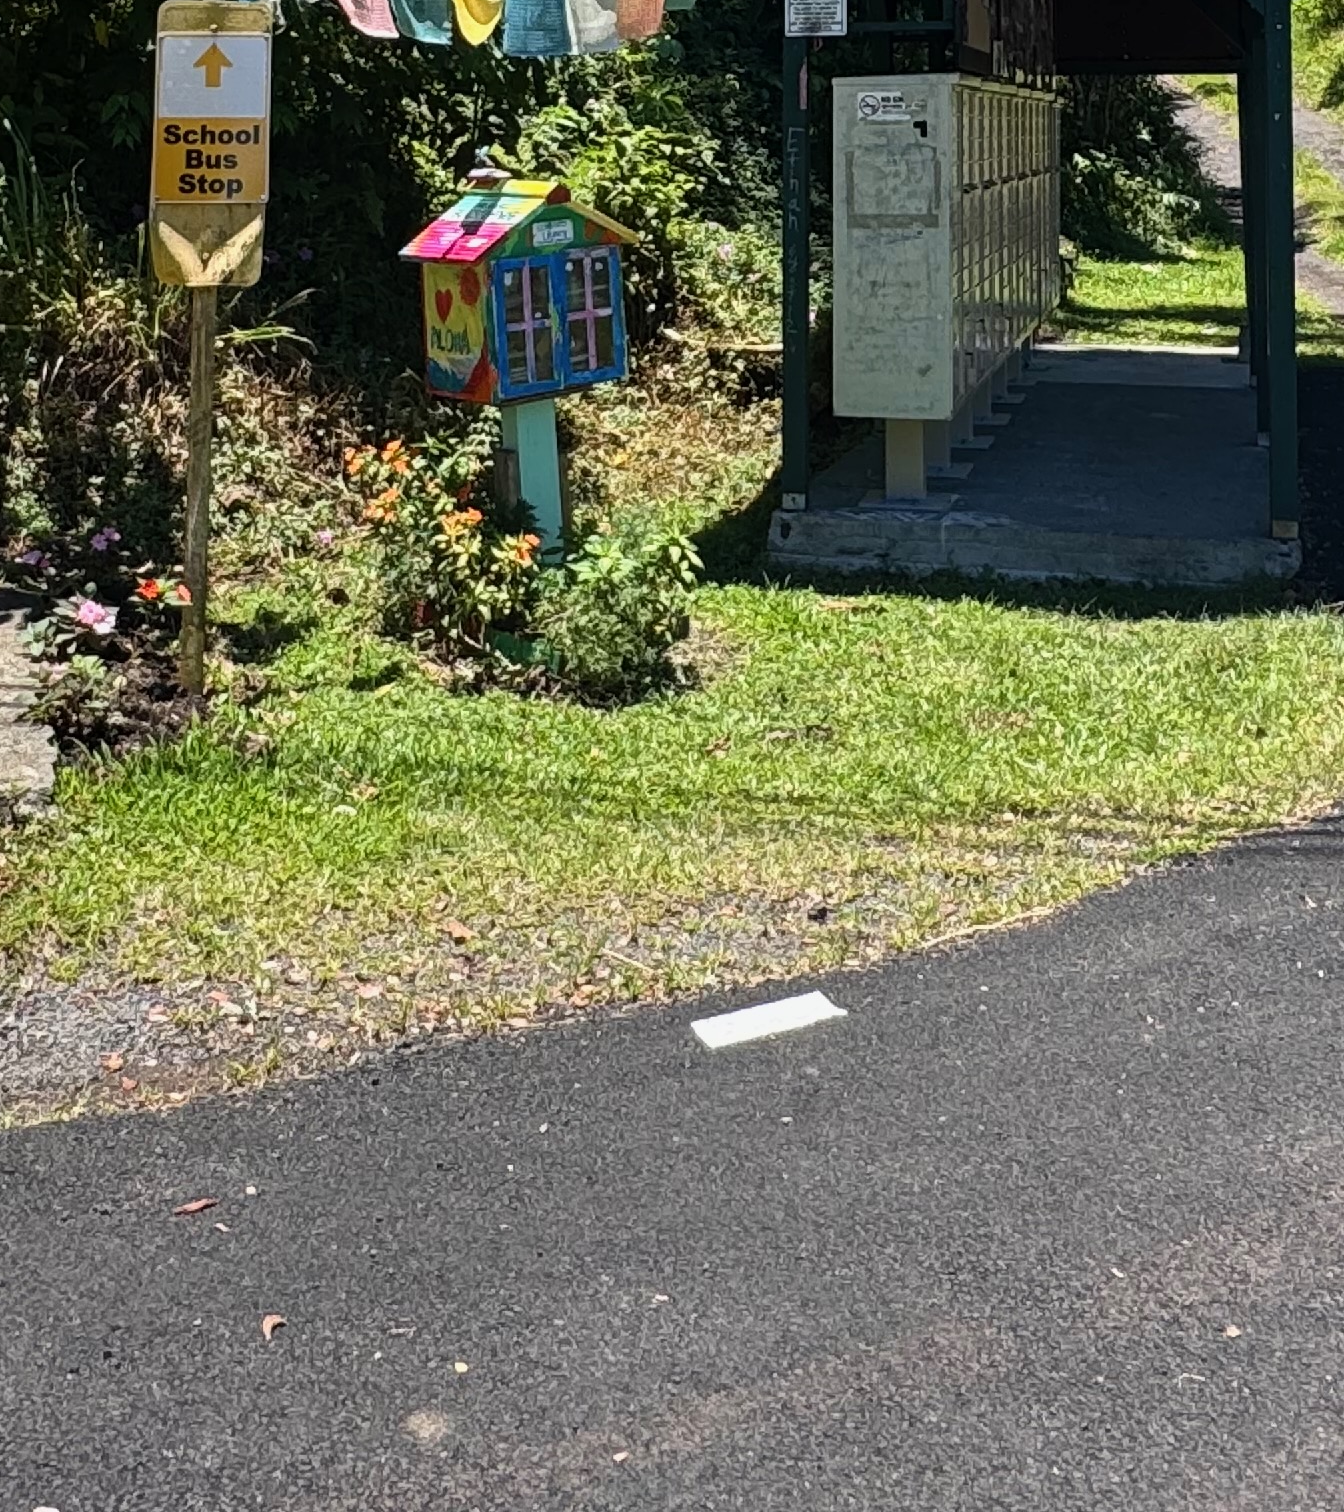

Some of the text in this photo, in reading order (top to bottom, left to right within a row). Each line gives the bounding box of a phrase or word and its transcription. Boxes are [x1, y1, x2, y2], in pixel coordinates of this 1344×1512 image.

[163, 124, 261, 145] School
[185, 149, 238, 169] Bus
[178, 173, 244, 199] Stop
